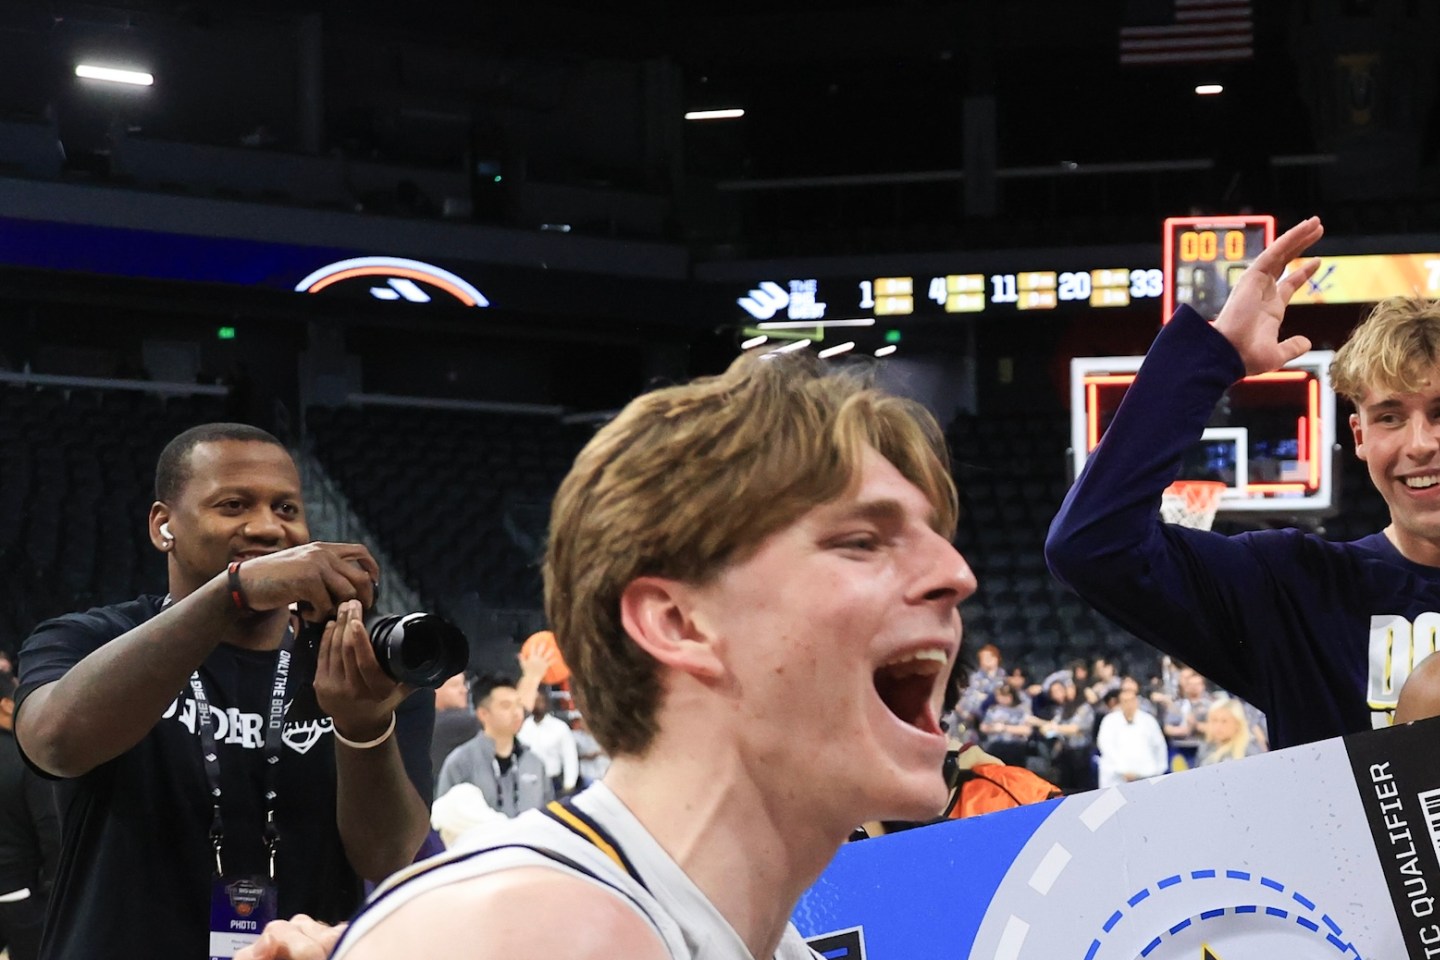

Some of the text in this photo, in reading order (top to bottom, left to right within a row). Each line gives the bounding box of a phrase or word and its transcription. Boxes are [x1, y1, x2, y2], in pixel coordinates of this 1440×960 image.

[858, 280, 874, 309] 1
[928, 277, 947, 305] 4
[990, 274, 1018, 303] 11
[1058, 271, 1091, 300] 20
[1129, 268, 1164, 298] 33
[272, 675, 290, 698] THE
[269, 698, 284, 729] BOLD
[1369, 761, 1435, 918] QUALIFIER
[230, 919, 257, 930] PHOTO
